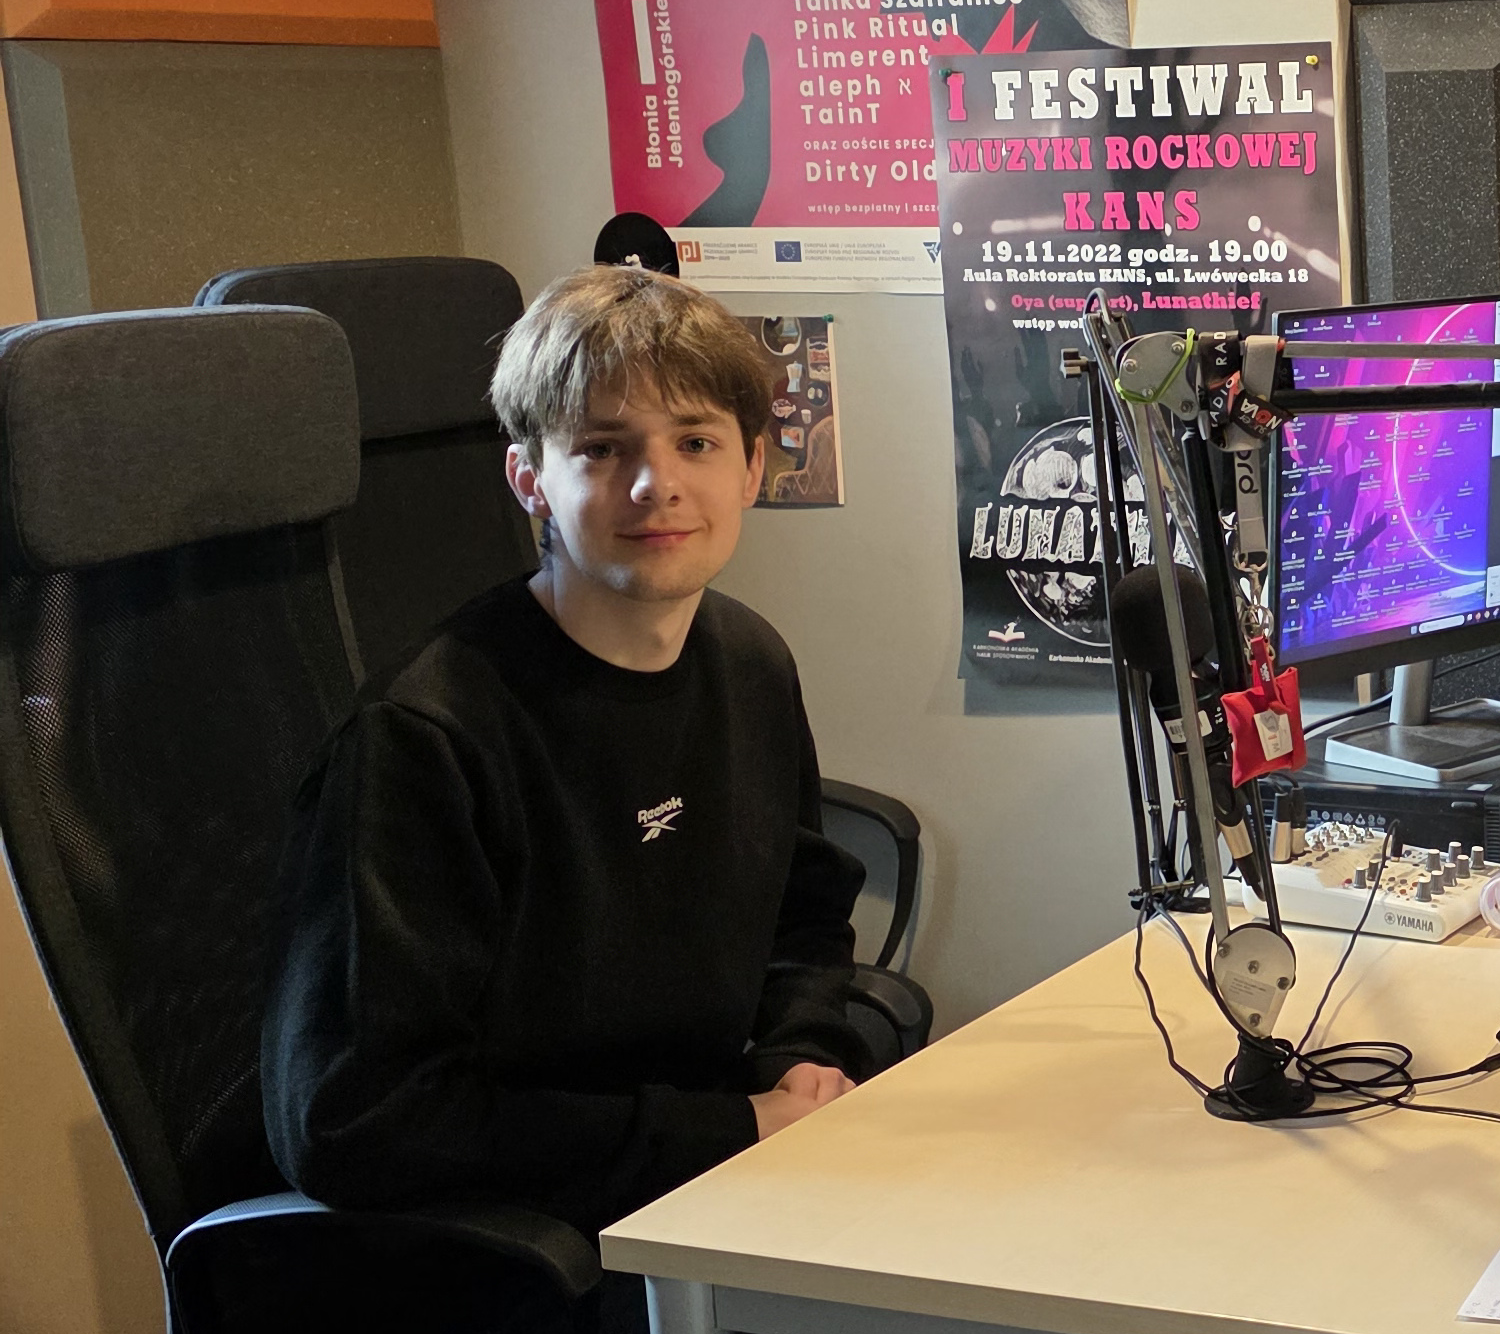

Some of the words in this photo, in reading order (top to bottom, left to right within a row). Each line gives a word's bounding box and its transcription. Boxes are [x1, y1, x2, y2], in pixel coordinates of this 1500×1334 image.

[794, 15, 858, 40] Pink
[868, 13, 960, 39] Ritual
[796, 43, 930, 69] Limerent
[799, 73, 882, 104] aleph
[947, 71, 968, 122] I
[991, 61, 1314, 121] FESTIWAL
[800, 101, 881, 126] TainT
[641, 94, 663, 169] Błonia
[803, 139, 838, 151] ORAZ
[842, 136, 891, 151] GOŚCIE
[947, 136, 1093, 173] MUZYKI
[1104, 131, 1318, 175] ROCKOWEJ
[805, 159, 878, 188] Dirty
[890, 158, 938, 183] Old
[807, 204, 842, 216] wstęp
[844, 203, 901, 215] bezpłatny
[1062, 190, 1200, 232] KANS
[981, 239, 1122, 264] 19.11.2022
[1126, 240, 1199, 267] godz.
[1207, 238, 1288, 263] 19.00
[962, 268, 1004, 284] Aula
[1006, 267, 1097, 284] Rektoratu
[1098, 268, 1152, 286] KANS,
[1154, 267, 1181, 284] ul.
[1183, 266, 1283, 284] Lwówecka
[1287, 268, 1310, 283] 18
[1010, 294, 1045, 311] Oya
[1141, 291, 1261, 310] Lunathief
[1012, 317, 1056, 331] wstęp
[1208, 377, 1235, 427] ADIO
[637, 796, 684, 824] Reebok
[1396, 913, 1434, 933] YAMAHA
